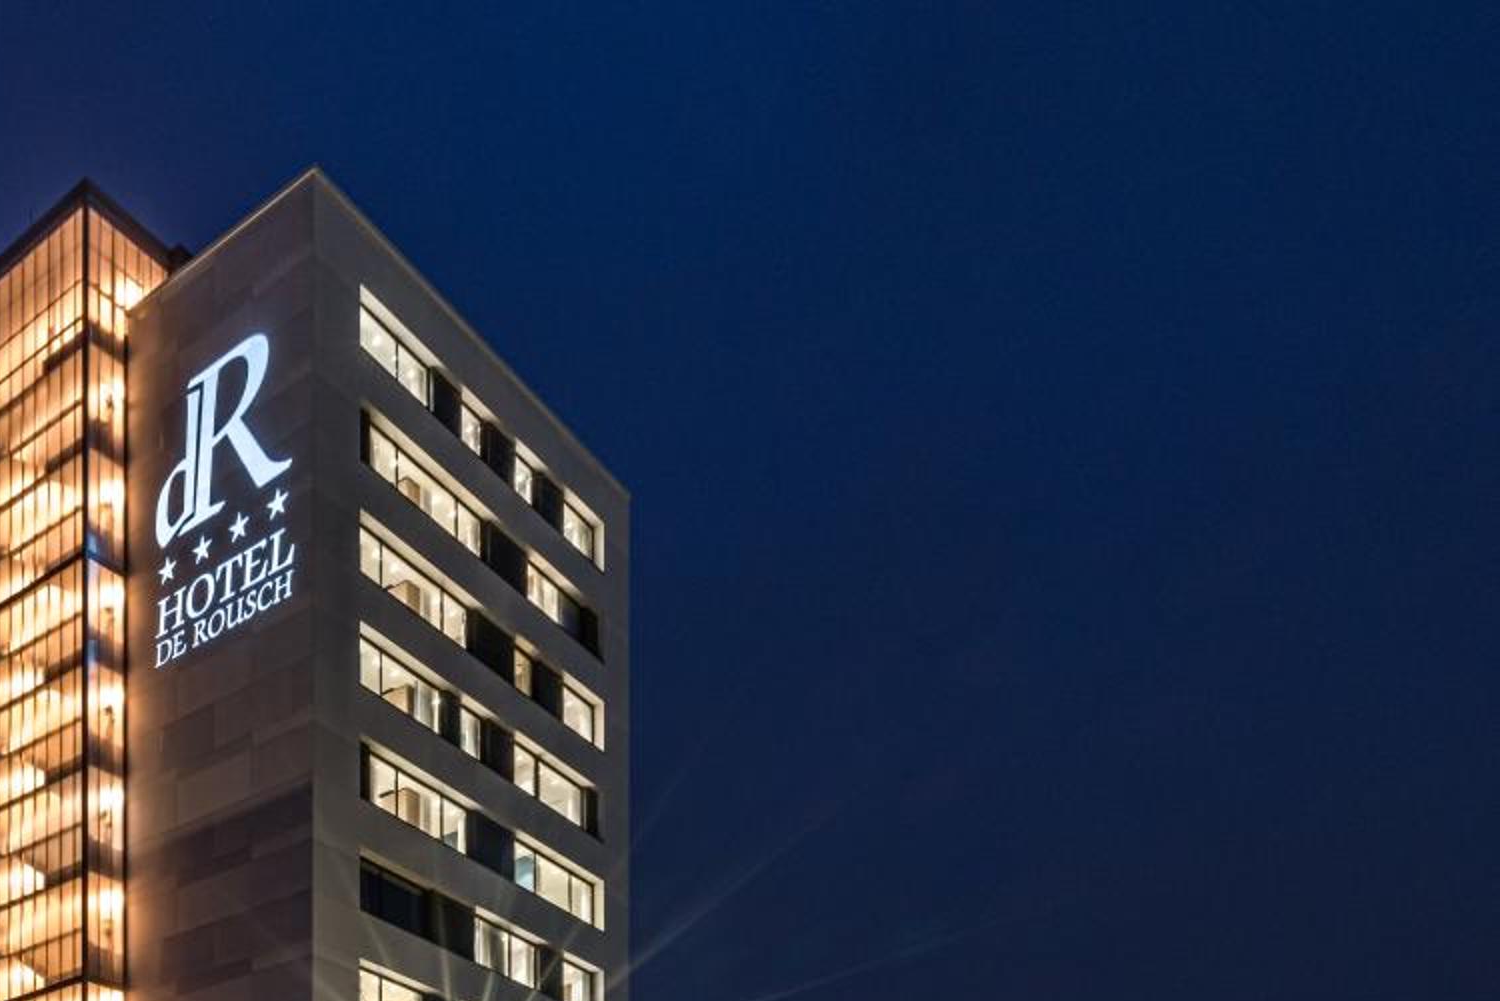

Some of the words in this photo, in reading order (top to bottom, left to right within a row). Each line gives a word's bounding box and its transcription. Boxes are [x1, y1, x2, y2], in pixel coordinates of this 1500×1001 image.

[154, 629, 187, 669] DE
[192, 569, 295, 648] ROUSCH
[155, 527, 296, 639] HOTEL
